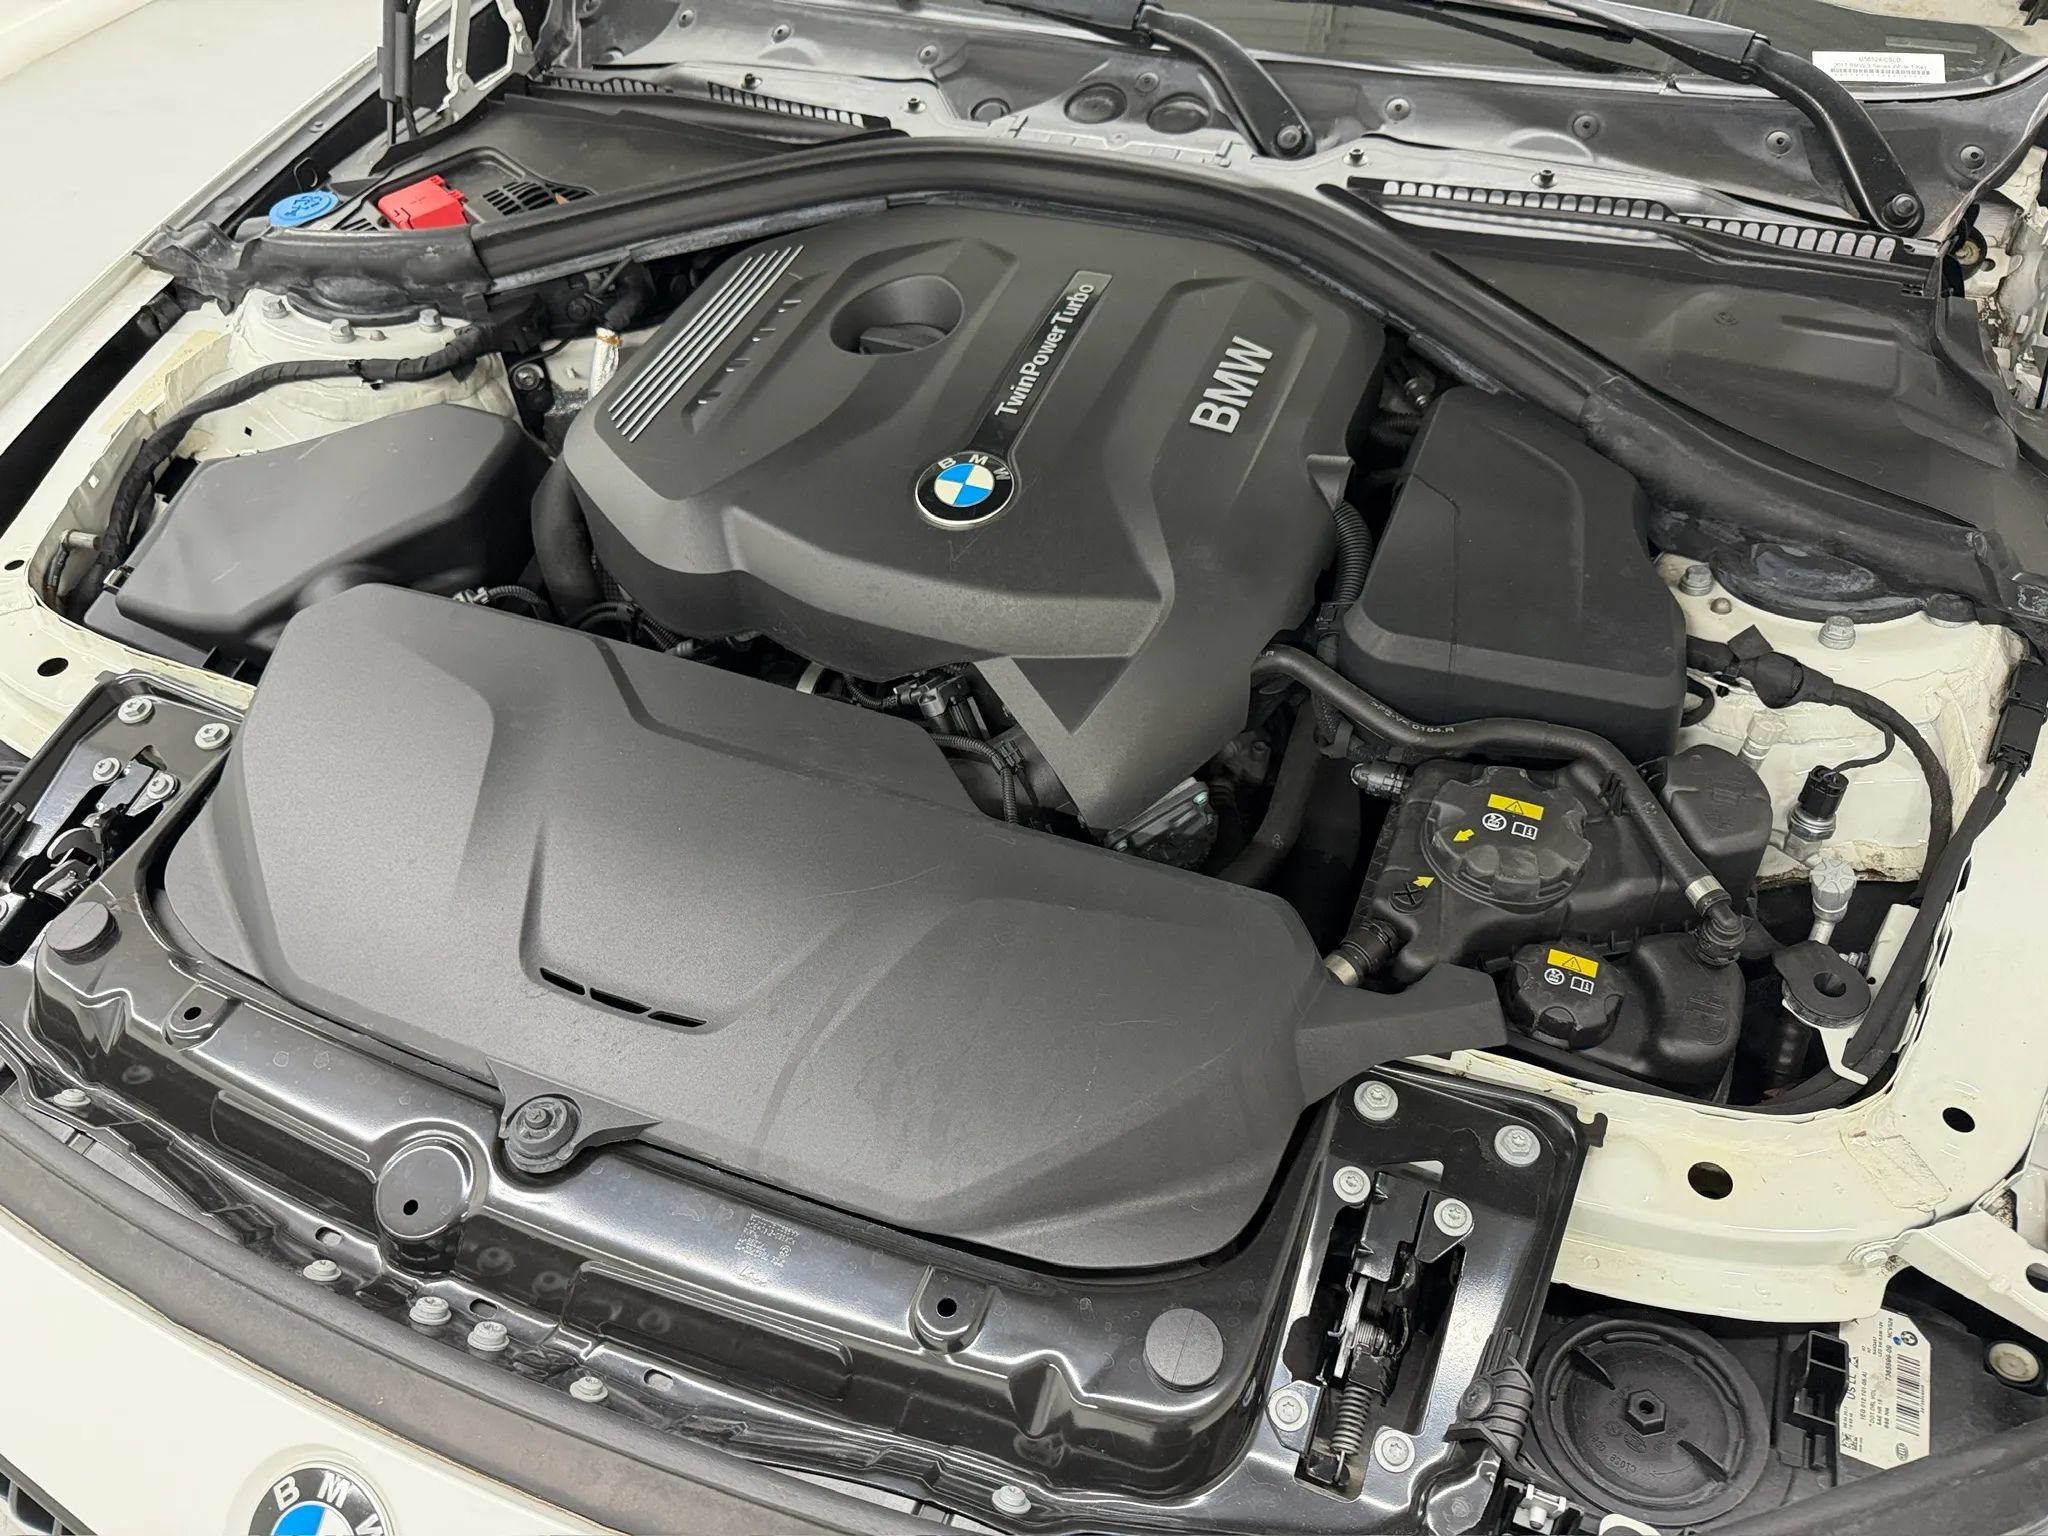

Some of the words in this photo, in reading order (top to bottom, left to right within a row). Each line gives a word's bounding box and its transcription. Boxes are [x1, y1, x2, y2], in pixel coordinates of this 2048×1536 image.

[994, 326, 1067, 417] TwinPower
[1050, 283, 1095, 329] Turbo
[1189, 335, 1273, 434] BMW
[937, 453, 1011, 481] BMW
